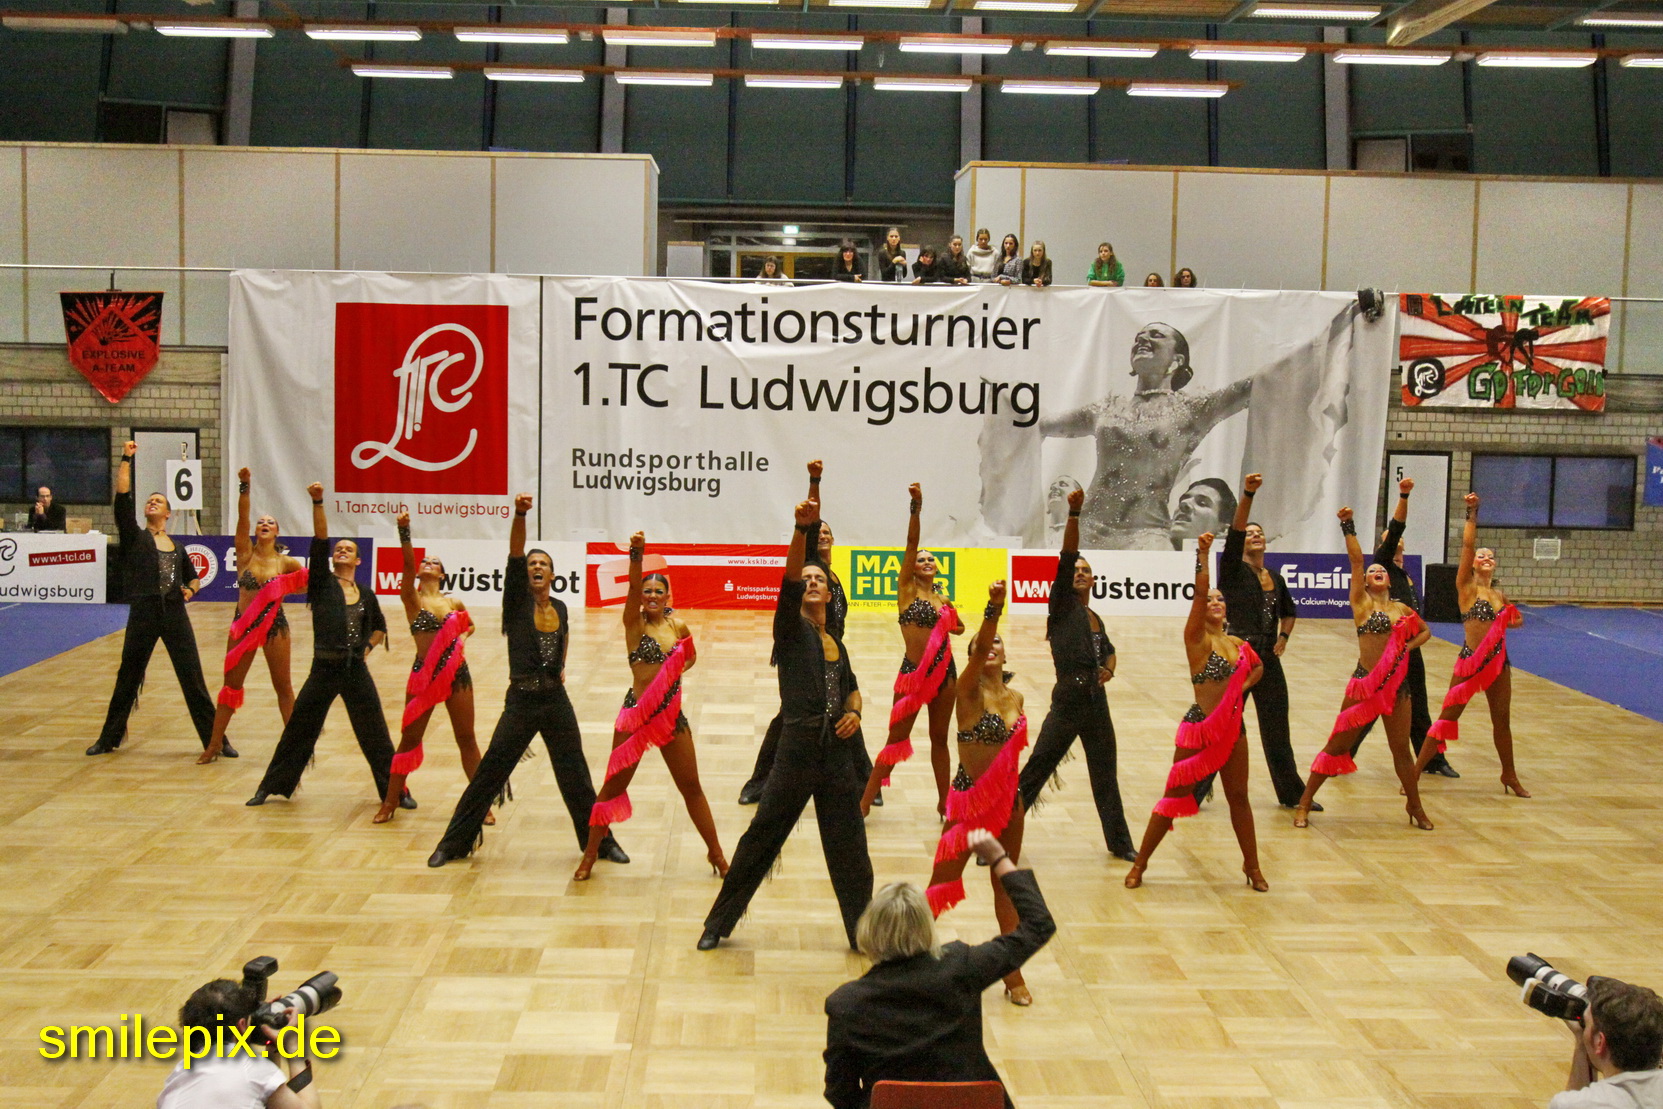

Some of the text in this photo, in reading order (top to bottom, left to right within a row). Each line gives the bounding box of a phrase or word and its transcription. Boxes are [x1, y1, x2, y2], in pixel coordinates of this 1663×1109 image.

[574, 296, 1041, 350] Formationsturnier
[82, 350, 145, 360] EXPLOSIVE
[92, 363, 135, 373] A-TEAM
[574, 362, 1041, 427] 1.TC Ludwigsburg
[571, 448, 769, 473] Rundsporthalle
[1396, 466, 1404, 483] 5
[174, 467, 194, 502] 6
[572, 470, 721, 498] Ludwigsburg
[335, 501, 510, 519] 1. Tanzclub Ludwigsburg
[32, 552, 92, 564] www.1-tcl.de
[856, 555, 949, 575] MAN
[0, 584, 94, 600] udwigsburg
[736, 585, 781, 593] Kreissparkass
[856, 576, 950, 596] FILR
[1092, 575, 1196, 600] üstenro
[736, 593, 778, 601] Ludwigsburg
[1300, 597, 1351, 607] Calcium-Magne
